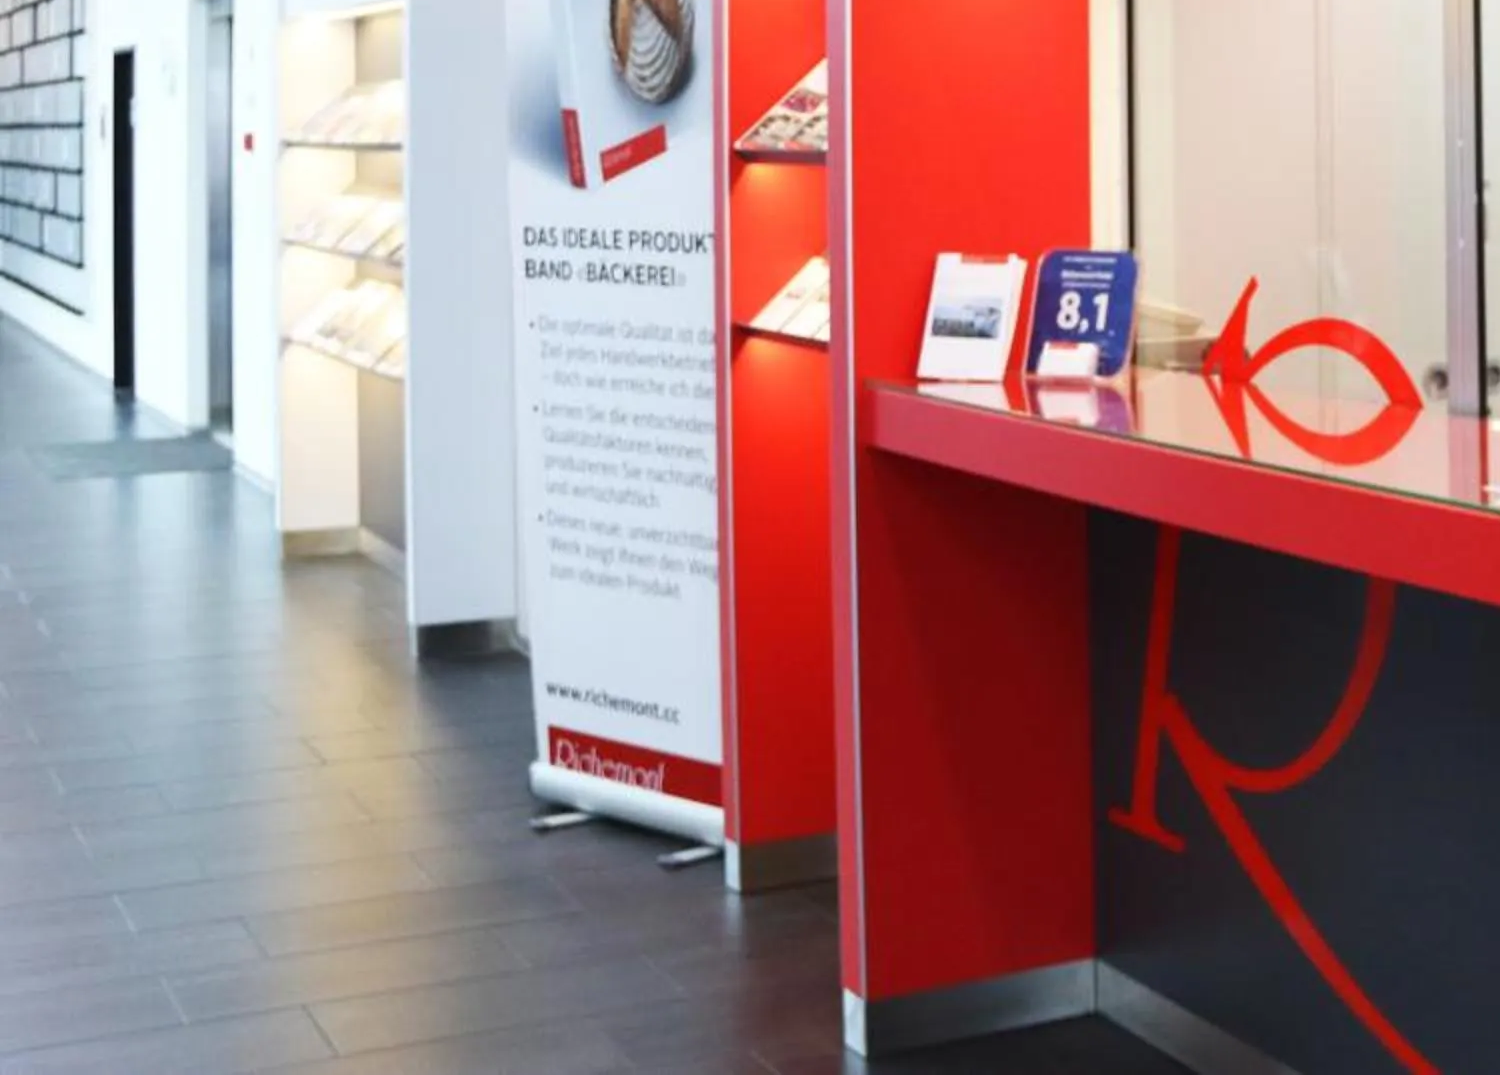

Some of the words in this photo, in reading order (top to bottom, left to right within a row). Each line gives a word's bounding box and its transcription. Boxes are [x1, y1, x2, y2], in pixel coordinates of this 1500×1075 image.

[523, 225, 558, 247] DAS
[562, 227, 623, 250] IDEALE
[525, 257, 573, 280] BAND
[1056, 291, 1109, 333] 8,1
